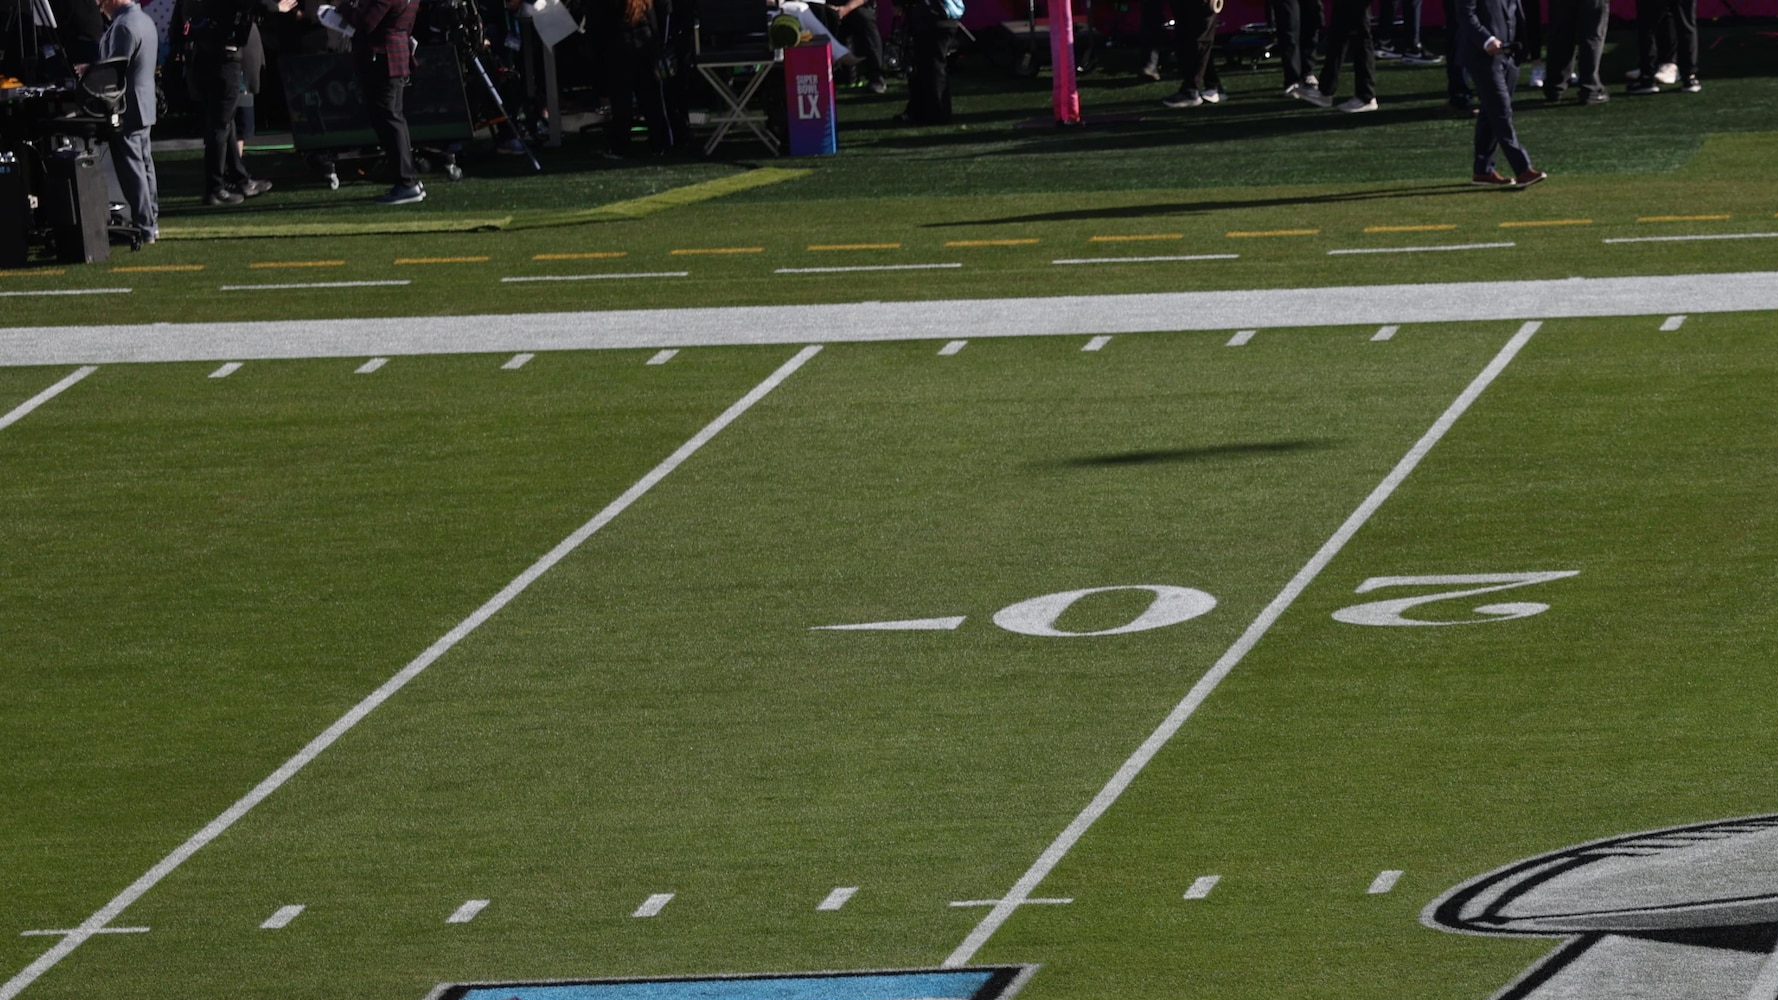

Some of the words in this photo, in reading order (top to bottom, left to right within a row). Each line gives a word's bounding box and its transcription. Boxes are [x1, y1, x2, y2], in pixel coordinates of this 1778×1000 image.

[796, 75, 818, 84] SUPER
[797, 84, 819, 95] BOWL
[798, 95, 821, 119] LX
